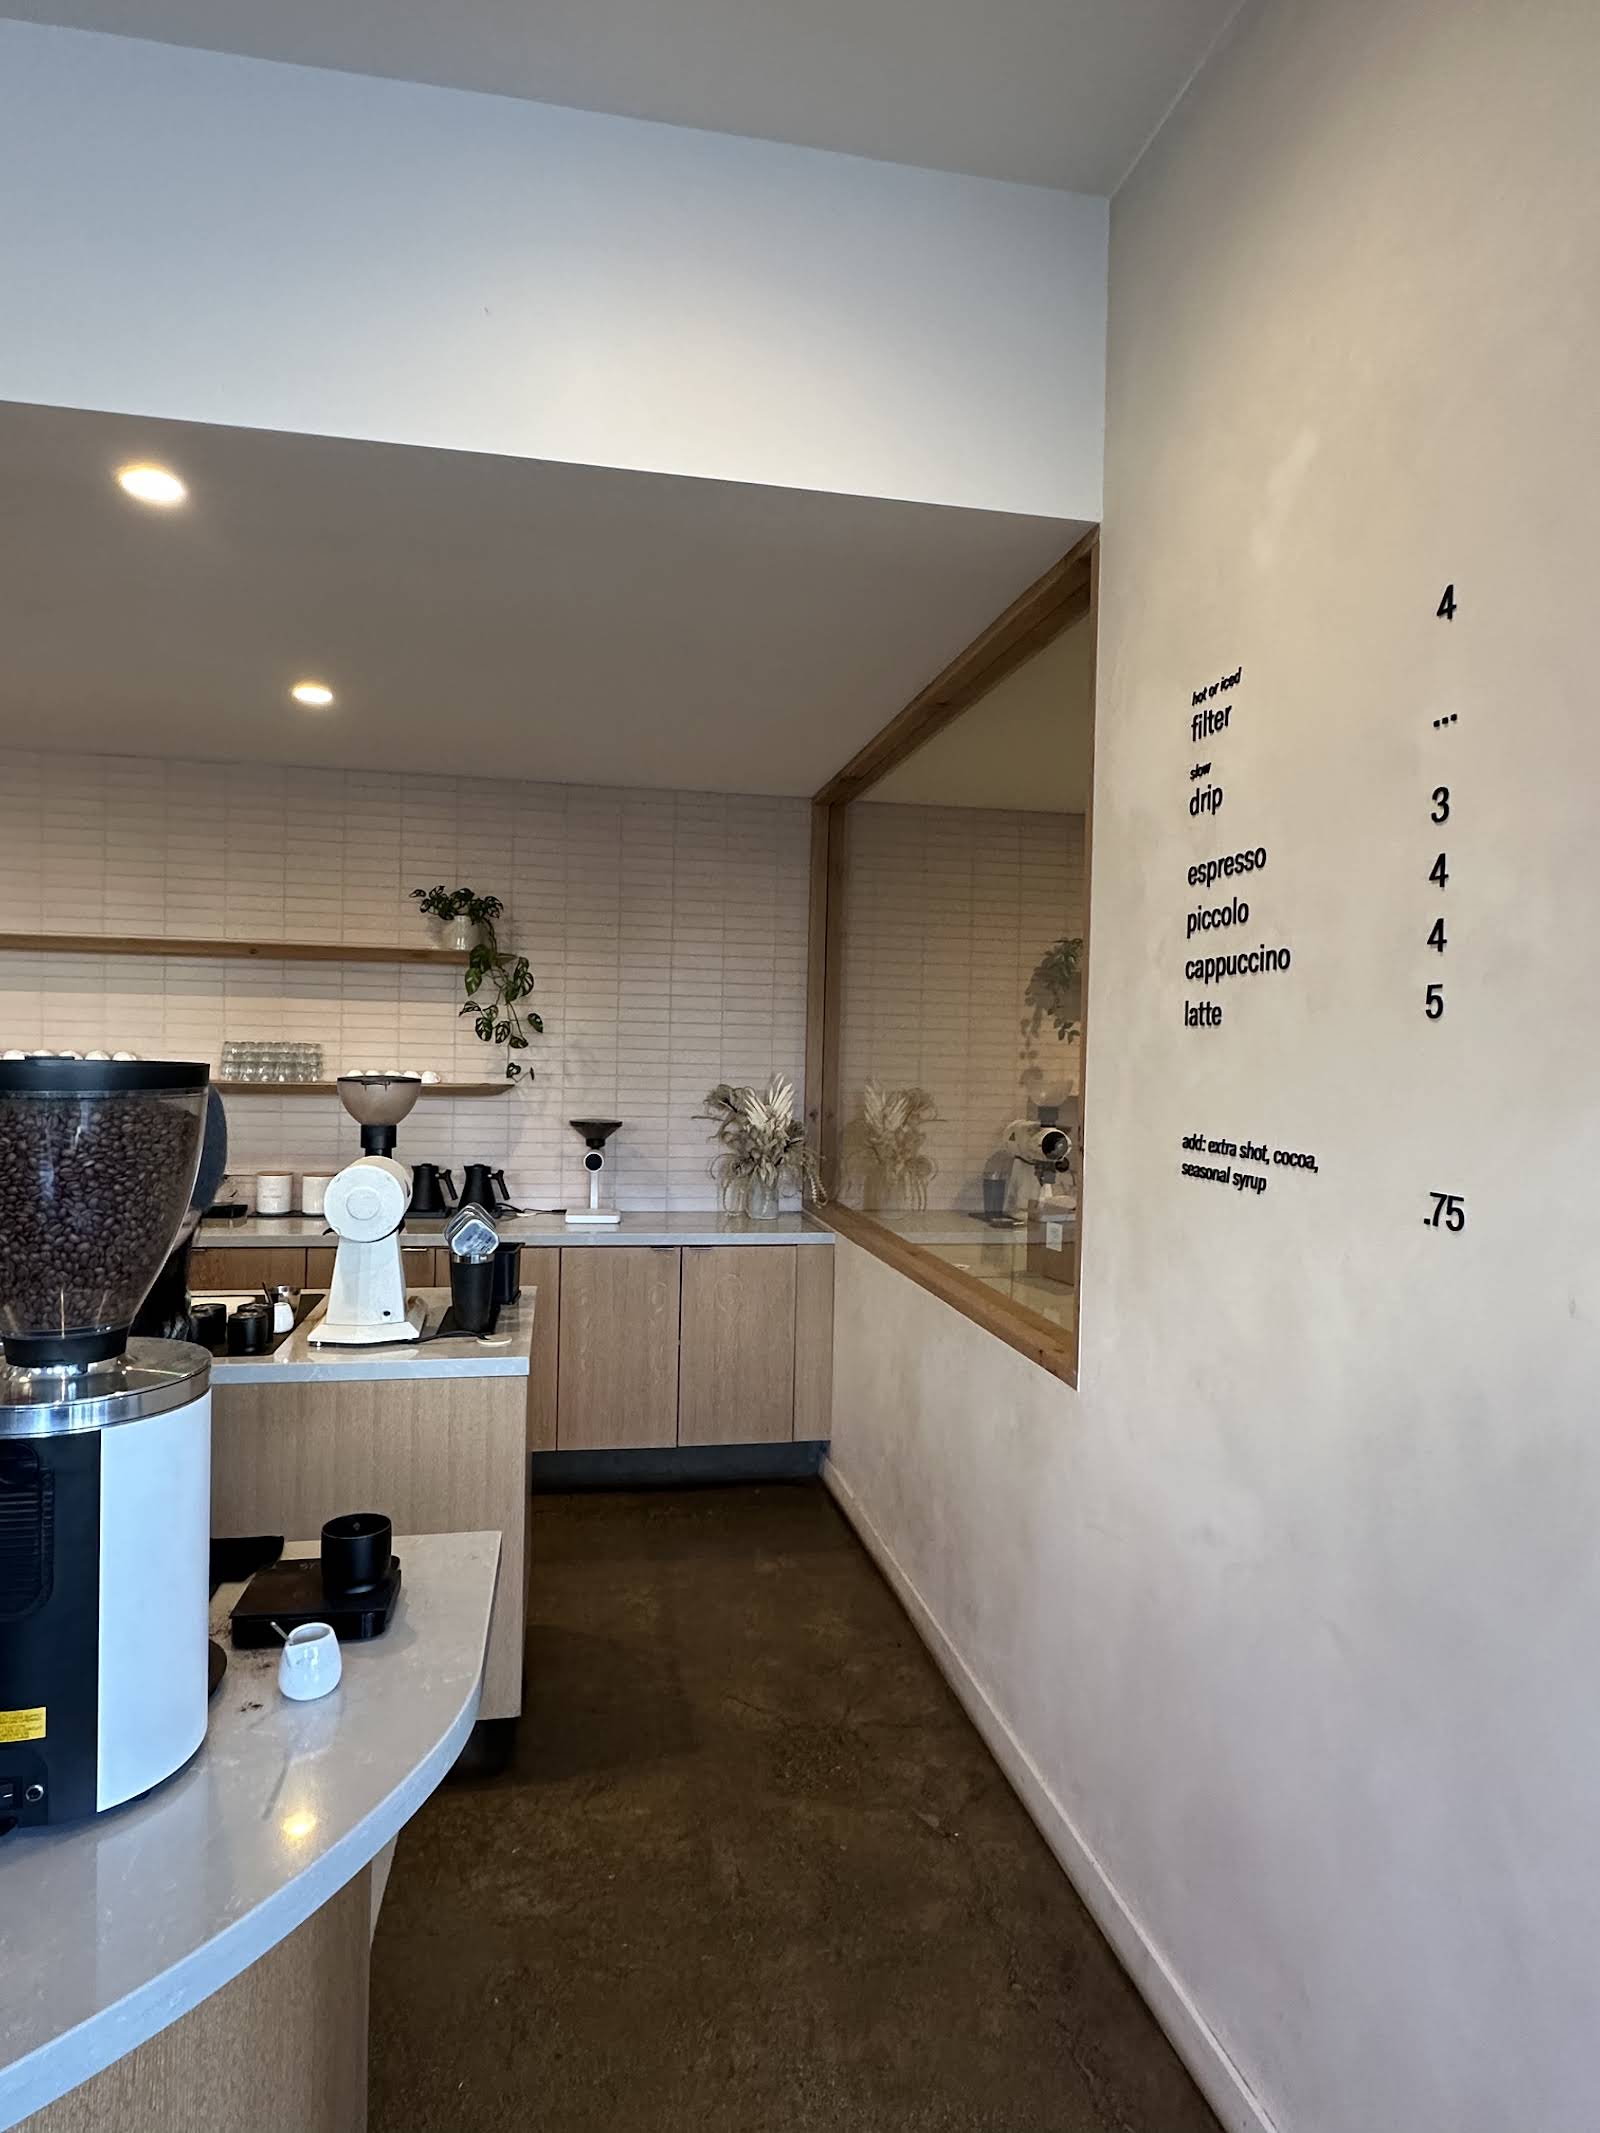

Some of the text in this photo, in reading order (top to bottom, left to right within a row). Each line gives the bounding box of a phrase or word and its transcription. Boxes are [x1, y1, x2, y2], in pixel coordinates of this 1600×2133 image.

[1436, 584, 1457, 620] 4
[1191, 666, 1242, 706] hot or iced
[1191, 705, 1232, 742] filter
[1190, 762, 1211, 780] slow
[1189, 784, 1223, 816] drip
[1431, 786, 1449, 823] 3
[1187, 847, 1267, 888] espresso
[1428, 853, 1449, 888] 4
[1187, 896, 1249, 939] piccolo
[1426, 918, 1447, 952] 4
[1185, 944, 1291, 985] cappuccino
[1184, 1001, 1222, 1027] latte
[1425, 984, 1443, 1019] 5
[1182, 1133, 1319, 1173] add: extra shot, cocoa,
[1181, 1163, 1267, 1195] seasonal syrup
[1424, 1192, 1465, 1231] .75
